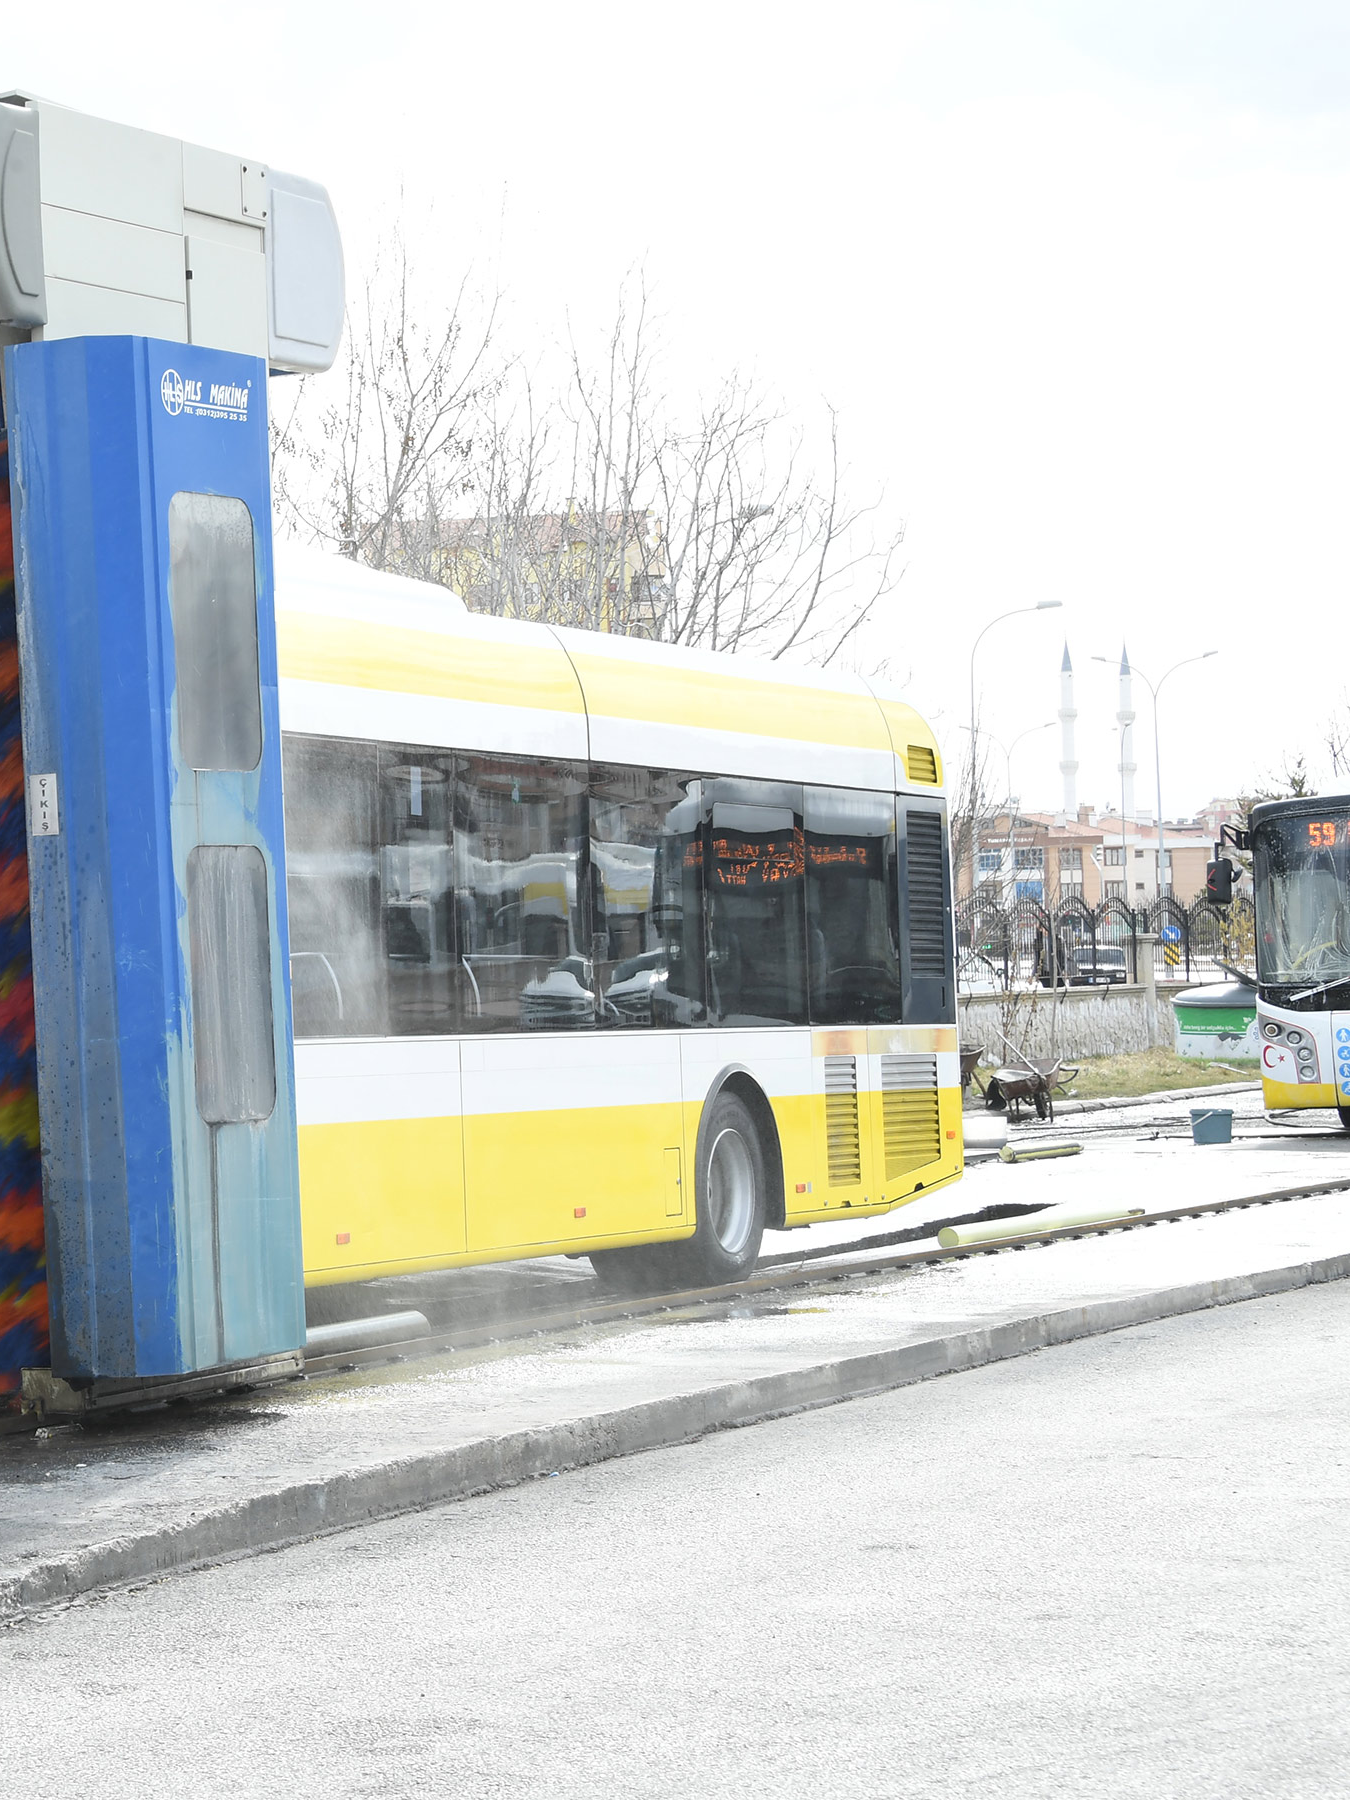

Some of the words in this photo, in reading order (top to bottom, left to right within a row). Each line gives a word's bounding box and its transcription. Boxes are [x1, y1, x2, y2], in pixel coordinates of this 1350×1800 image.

[184, 379, 202, 401] HLS
[184, 405, 193, 414] TEL
[38, 778, 49, 831] ÇIKIŞ
[1308, 822, 1335, 846] 59
